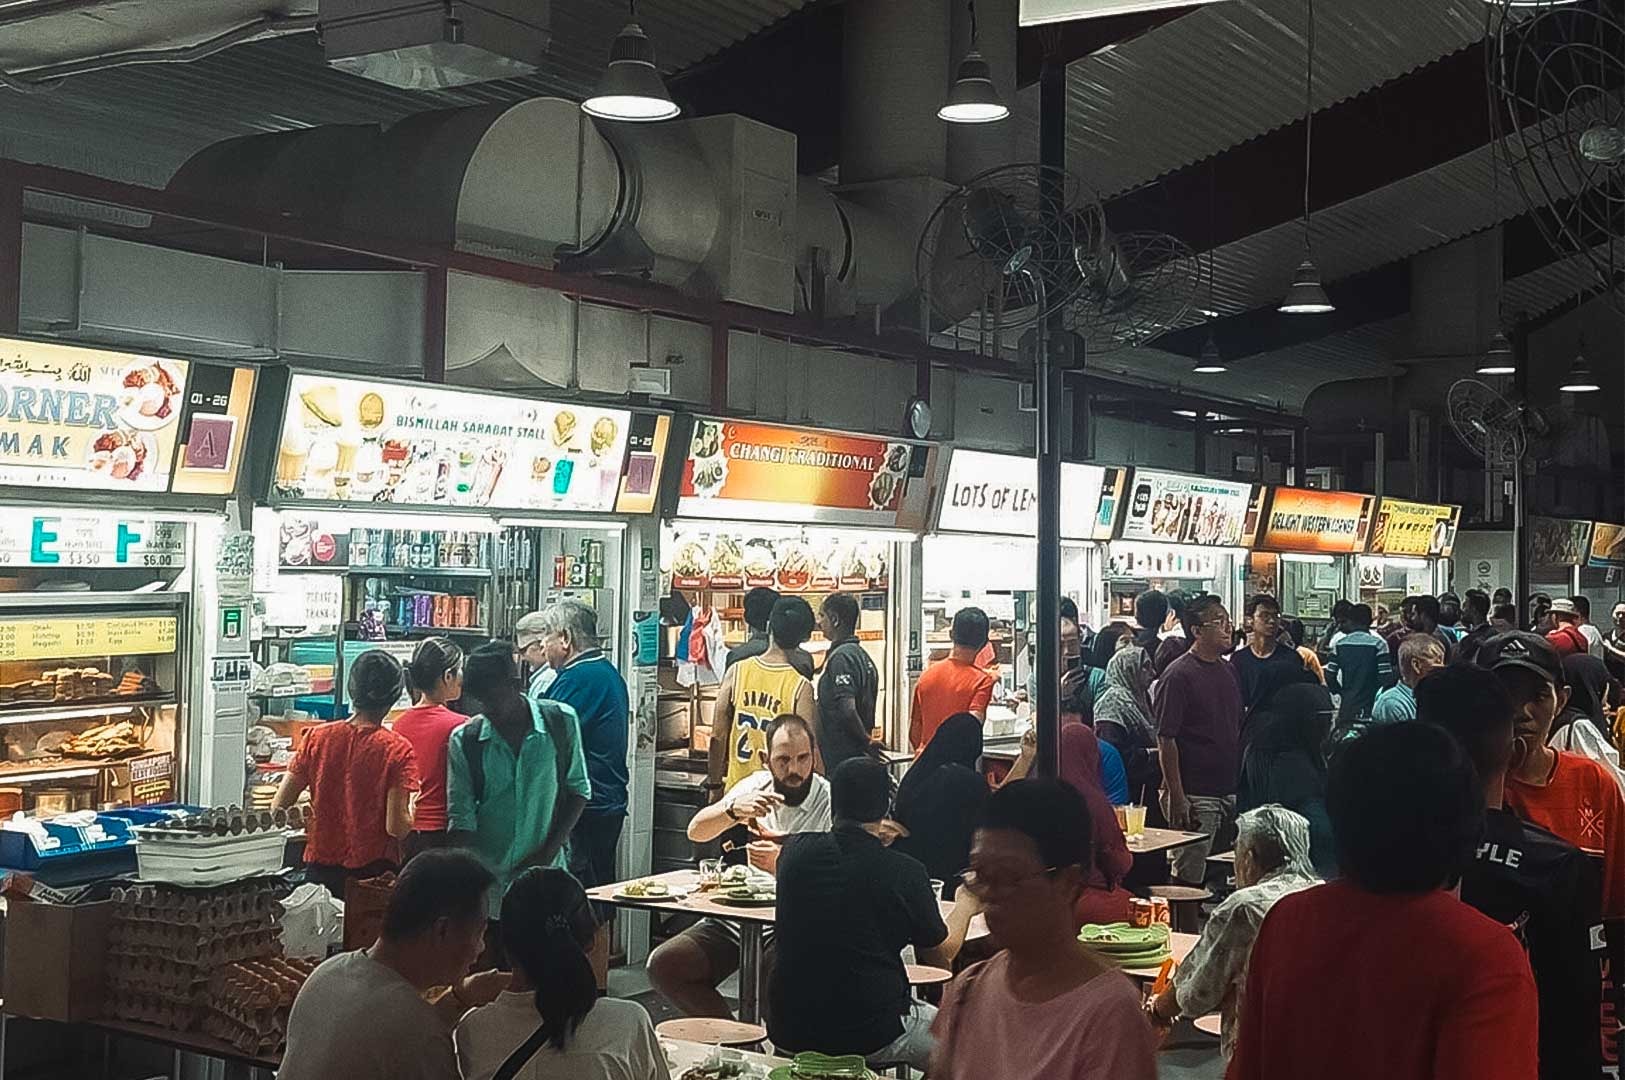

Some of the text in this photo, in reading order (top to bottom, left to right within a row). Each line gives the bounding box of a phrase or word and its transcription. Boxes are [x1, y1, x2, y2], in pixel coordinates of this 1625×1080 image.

[0, 386, 120, 431] RNER
[396, 414, 458, 431] BISMILLAH
[516, 426, 545, 440] STALL
[729, 443, 876, 472] CHANGI TRADITIONAL
[952, 482, 988, 507] LOTS
[992, 487, 1010, 510] OF
[31, 517, 61, 563] E
